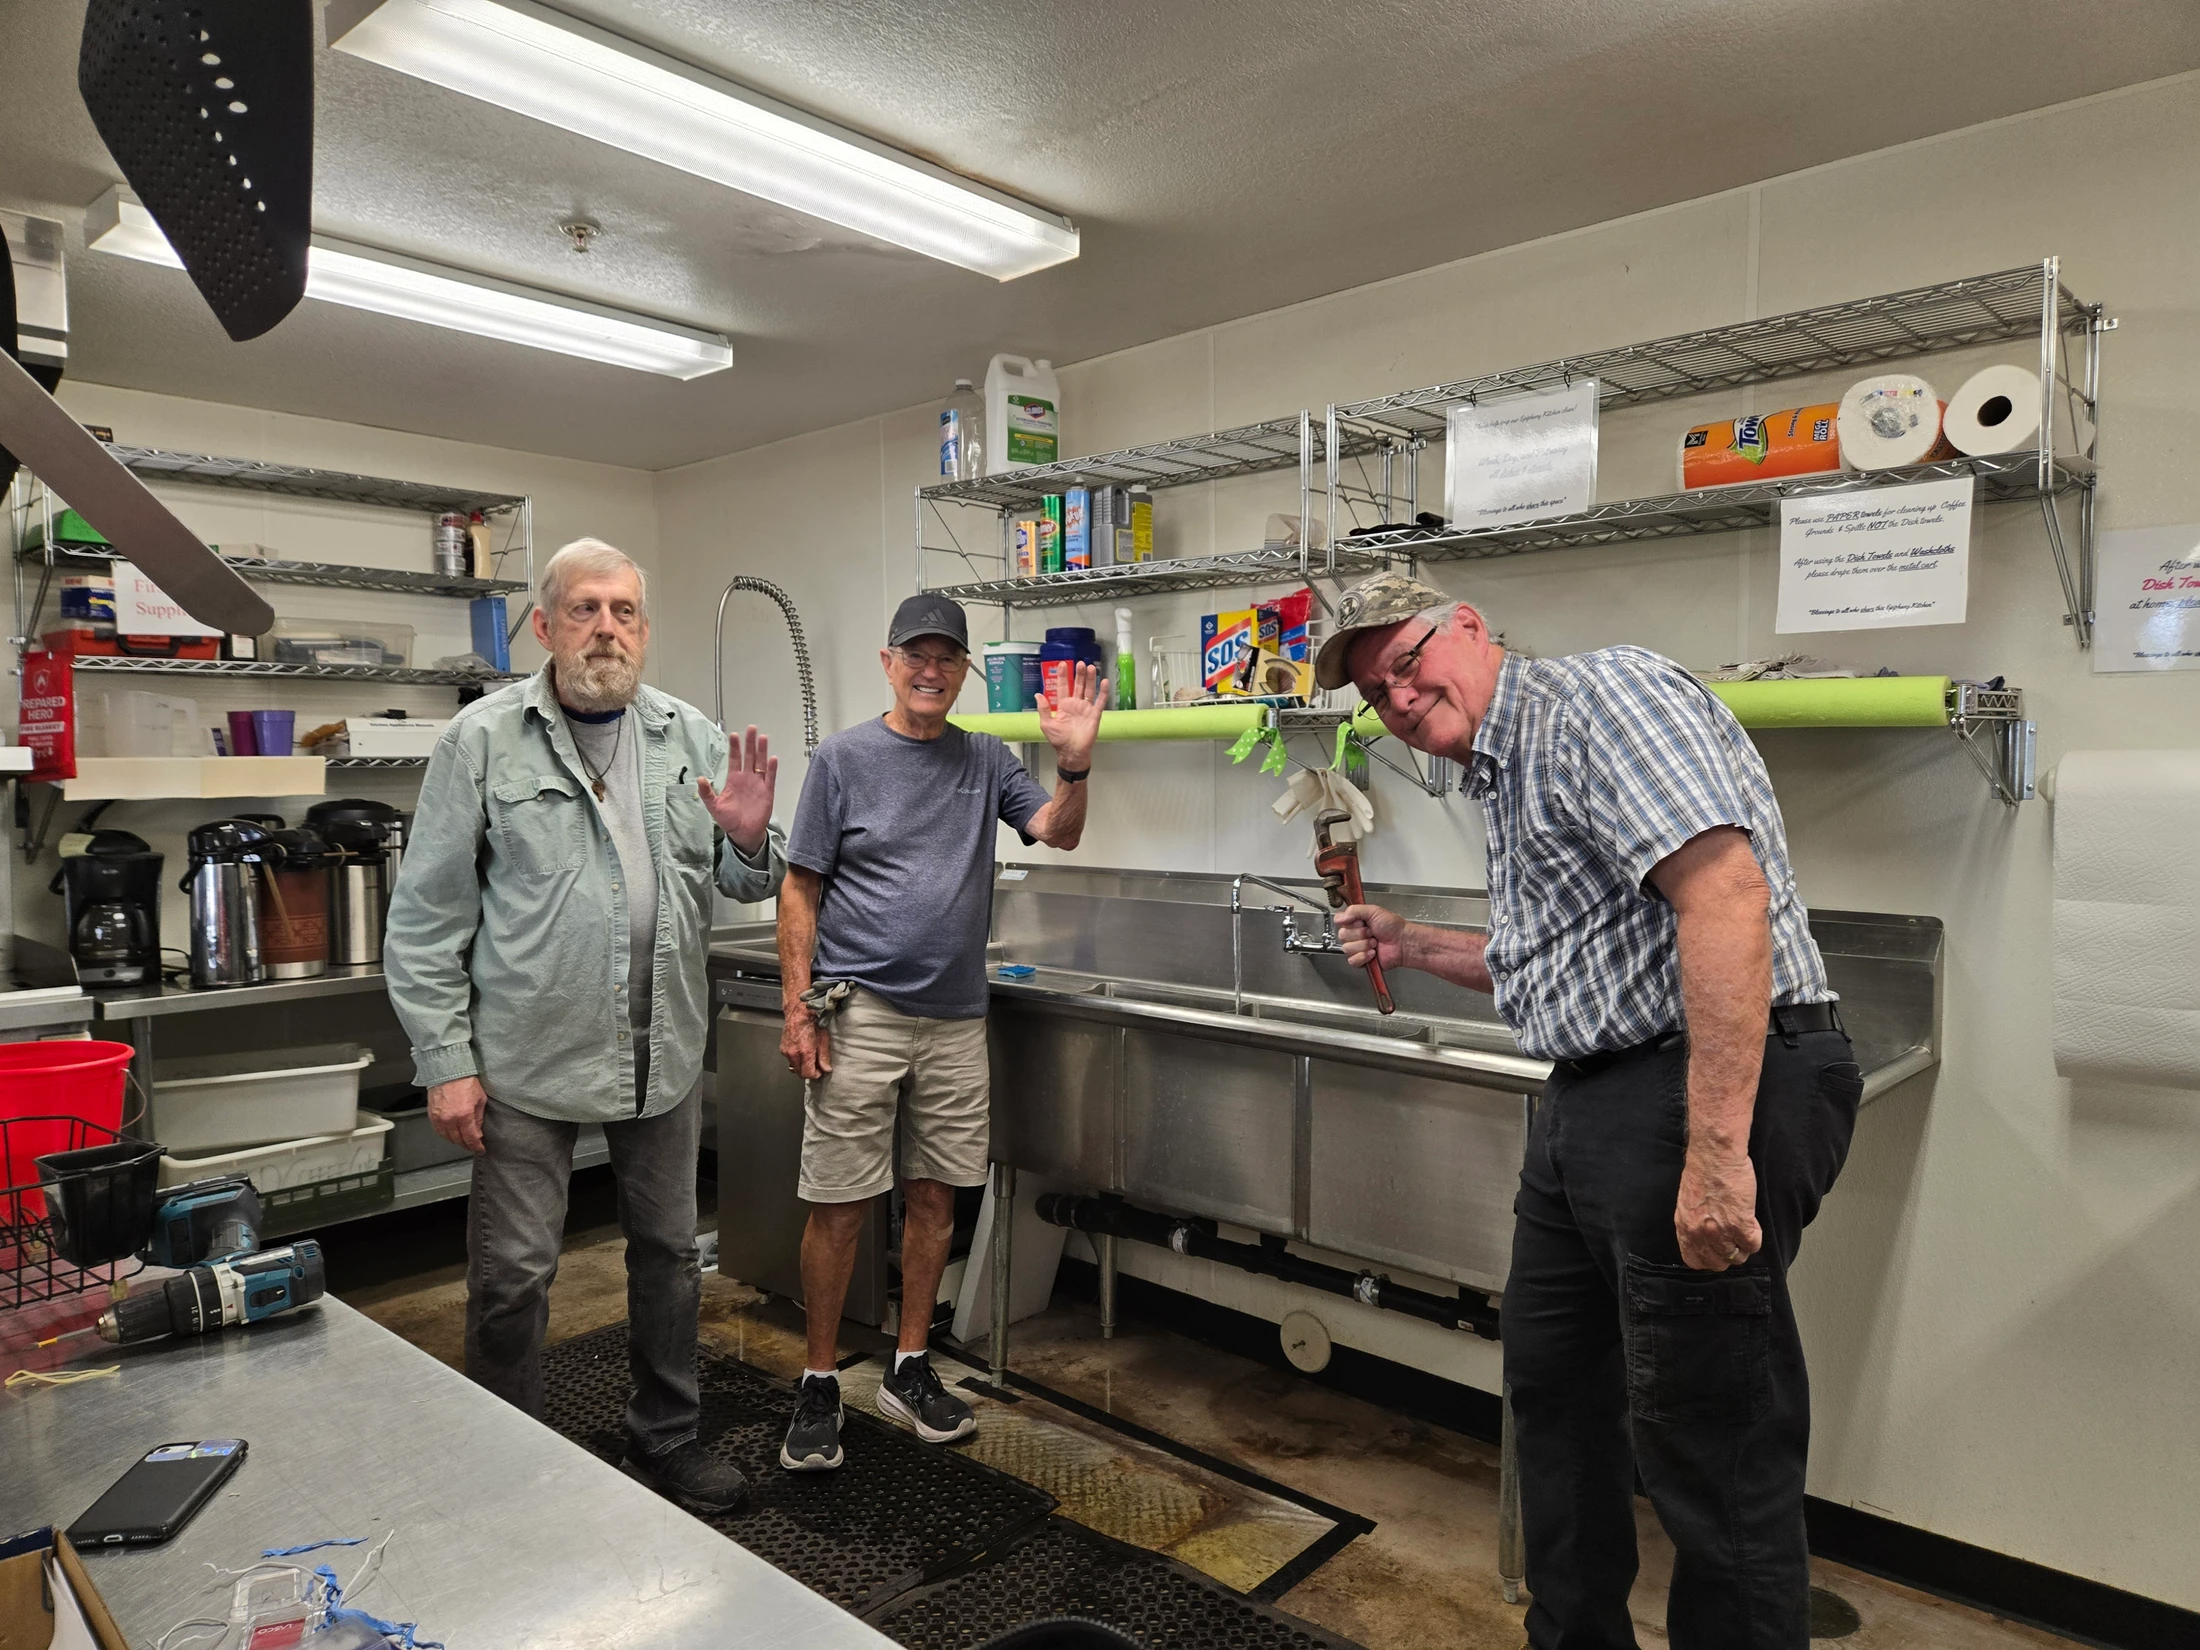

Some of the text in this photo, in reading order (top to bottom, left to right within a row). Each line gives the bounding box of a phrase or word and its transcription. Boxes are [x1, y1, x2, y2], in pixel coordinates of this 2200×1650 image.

[1787, 420, 1798, 437] Strong
[1813, 420, 1822, 441] MEGA
[1820, 419, 1830, 441] ROLL
[1789, 517, 1811, 525] Please
[1825, 511, 1860, 523] PAPER
[1860, 508, 1881, 518] towels
[1882, 508, 1896, 518] for
[1897, 505, 1926, 514] cleaning
[1927, 504, 1938, 513] up
[1940, 500, 1966, 511] Coffee
[1805, 526, 1834, 538] Grounds
[1844, 523, 1866, 534] Spills
[1867, 520, 1889, 531] NOT
[1888, 519, 1899, 528] the
[1900, 518, 1919, 526] Dish
[1794, 544, 1955, 568] After using the Dish Towels and Washcloths
[1805, 569, 1829, 580] please
[1830, 568, 1851, 577] drape
[1852, 566, 1869, 574] them
[1887, 563, 1898, 571] the
[1899, 560, 1921, 572] metal
[2159, 559, 2191, 575] After
[134, 579, 163, 594] Fir
[2142, 577, 2174, 591] Dish
[2129, 600, 2143, 609] at
[22, 697, 66, 709] REPARED
[28, 709, 54, 720] HERO
[257, 1623, 292, 1634] LASCO
